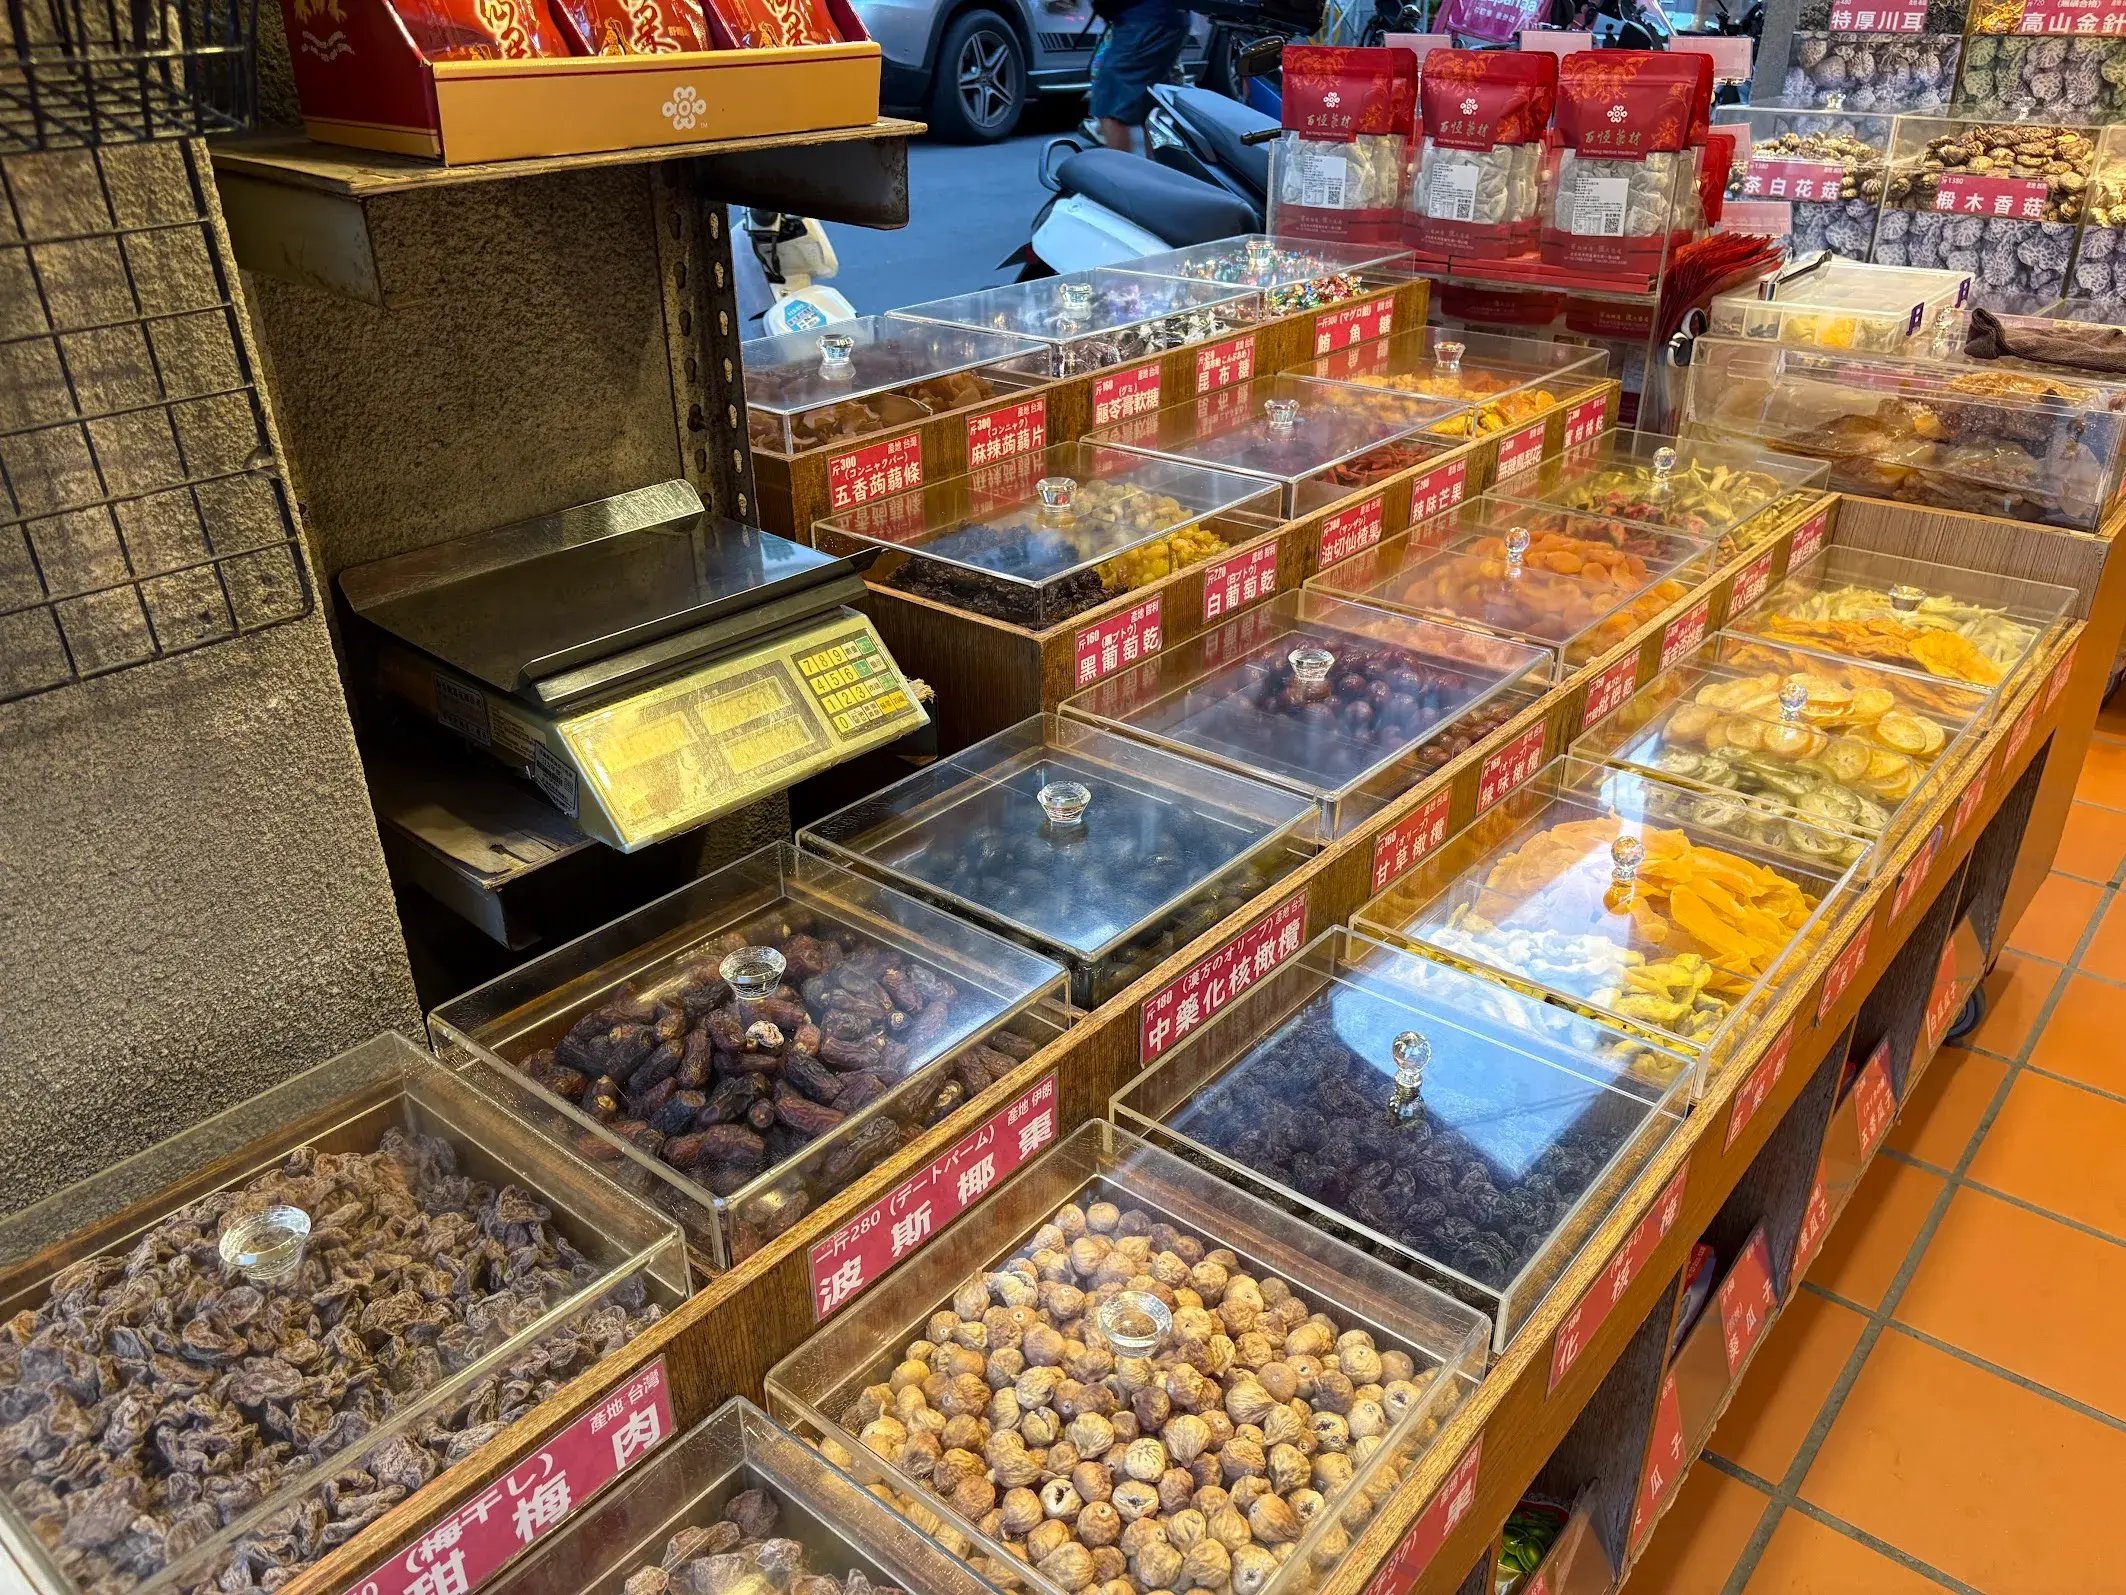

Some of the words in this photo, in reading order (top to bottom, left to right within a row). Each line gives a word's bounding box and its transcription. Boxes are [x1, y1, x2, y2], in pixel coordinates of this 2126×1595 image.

[1832, 10, 1925, 32] 特厚川耳
[2021, 12, 2126, 35] 高山金針
[1743, 175, 1841, 200] 茶白花菇
[1936, 190, 2045, 217] 椴木香菇
[1316, 314, 1392, 354] 鮪魚糖
[1198, 358, 1250, 392] 昆布糖
[971, 424, 1044, 465] 麻辣蒟蒻片
[831, 456, 857, 477] 一斤300
[834, 461, 921, 507] 五香蒟蒻條
[1413, 480, 1462, 523] 辣味芒果
[1207, 568, 1276, 618] 白葡萄乾
[803, 660, 813, 673] 7
[818, 653, 828, 667] 8
[832, 649, 842, 661] 9
[1080, 625, 1162, 684] 黑葡萄乾
[816, 678, 826, 691] 4
[829, 673, 839, 686] 5
[844, 667, 854, 680] 6
[826, 699, 836, 711] 1
[842, 692, 852, 705] 2
[856, 686, 866, 698] 3
[839, 716, 849, 729] 0
[1481, 747, 1541, 810] 辣味橄欖
[1375, 816, 1446, 887] 甘草橄欖
[1149, 917, 1301, 1052] 中藥化核橄欖
[1146, 990, 1173, 1024] 一斤180
[1007, 1097, 1029, 1126] 產地
[1031, 1080, 1053, 1106] 伊朗
[889, 1124, 994, 1216] (デートパーム)
[819, 1108, 1053, 1313] 波斯椰棗
[815, 1209, 881, 1264] 一斤280
[1558, 1192, 1679, 1375] 化核梅
[590, 1398, 624, 1435] 產地
[627, 1369, 660, 1405] 台灣
[406, 1452, 553, 1573] (梅干し)
